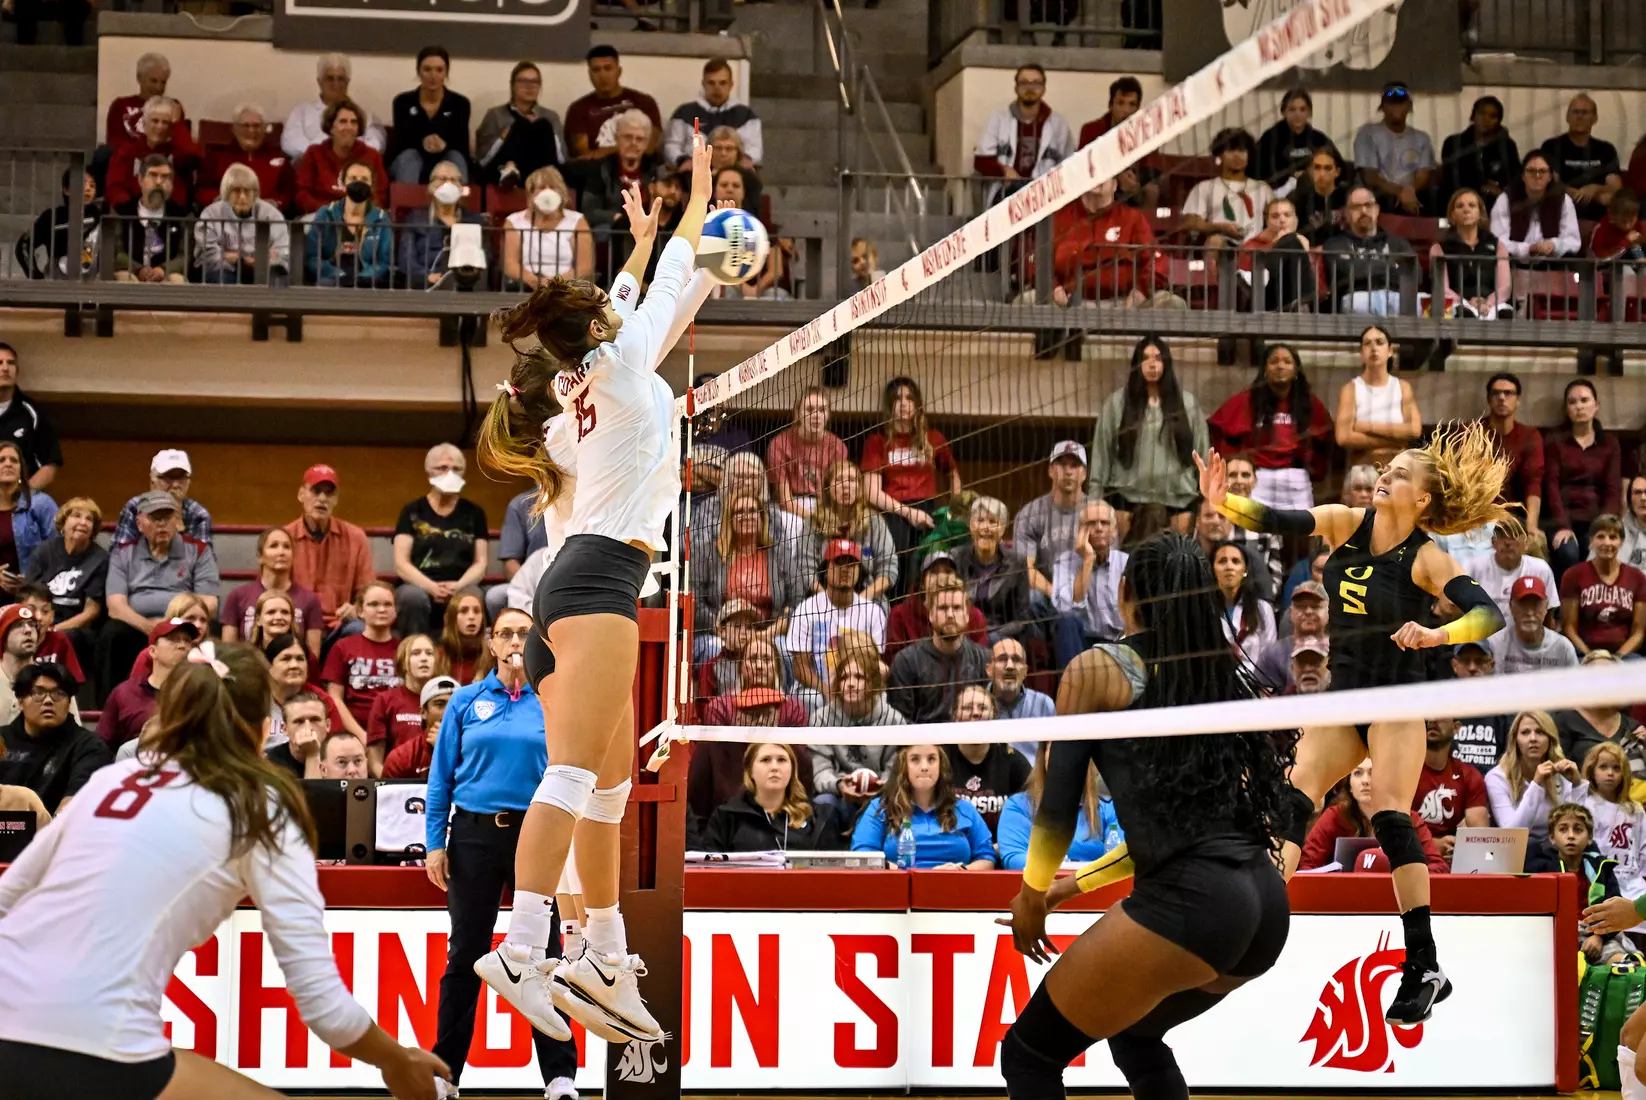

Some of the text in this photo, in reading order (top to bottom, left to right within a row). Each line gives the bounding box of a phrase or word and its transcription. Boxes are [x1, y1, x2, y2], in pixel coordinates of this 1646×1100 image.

[574, 387, 597, 443] 15
[1524, 578, 1534, 588] W
[1580, 584, 1634, 611] COUGARS
[348, 657, 396, 675] WS
[1453, 724, 1497, 743] OLSO
[93, 769, 180, 820] 8
[1465, 836, 1500, 844] WASHINGTON
[1363, 853, 1376, 869] W
[828, 934, 1086, 1067] STA
